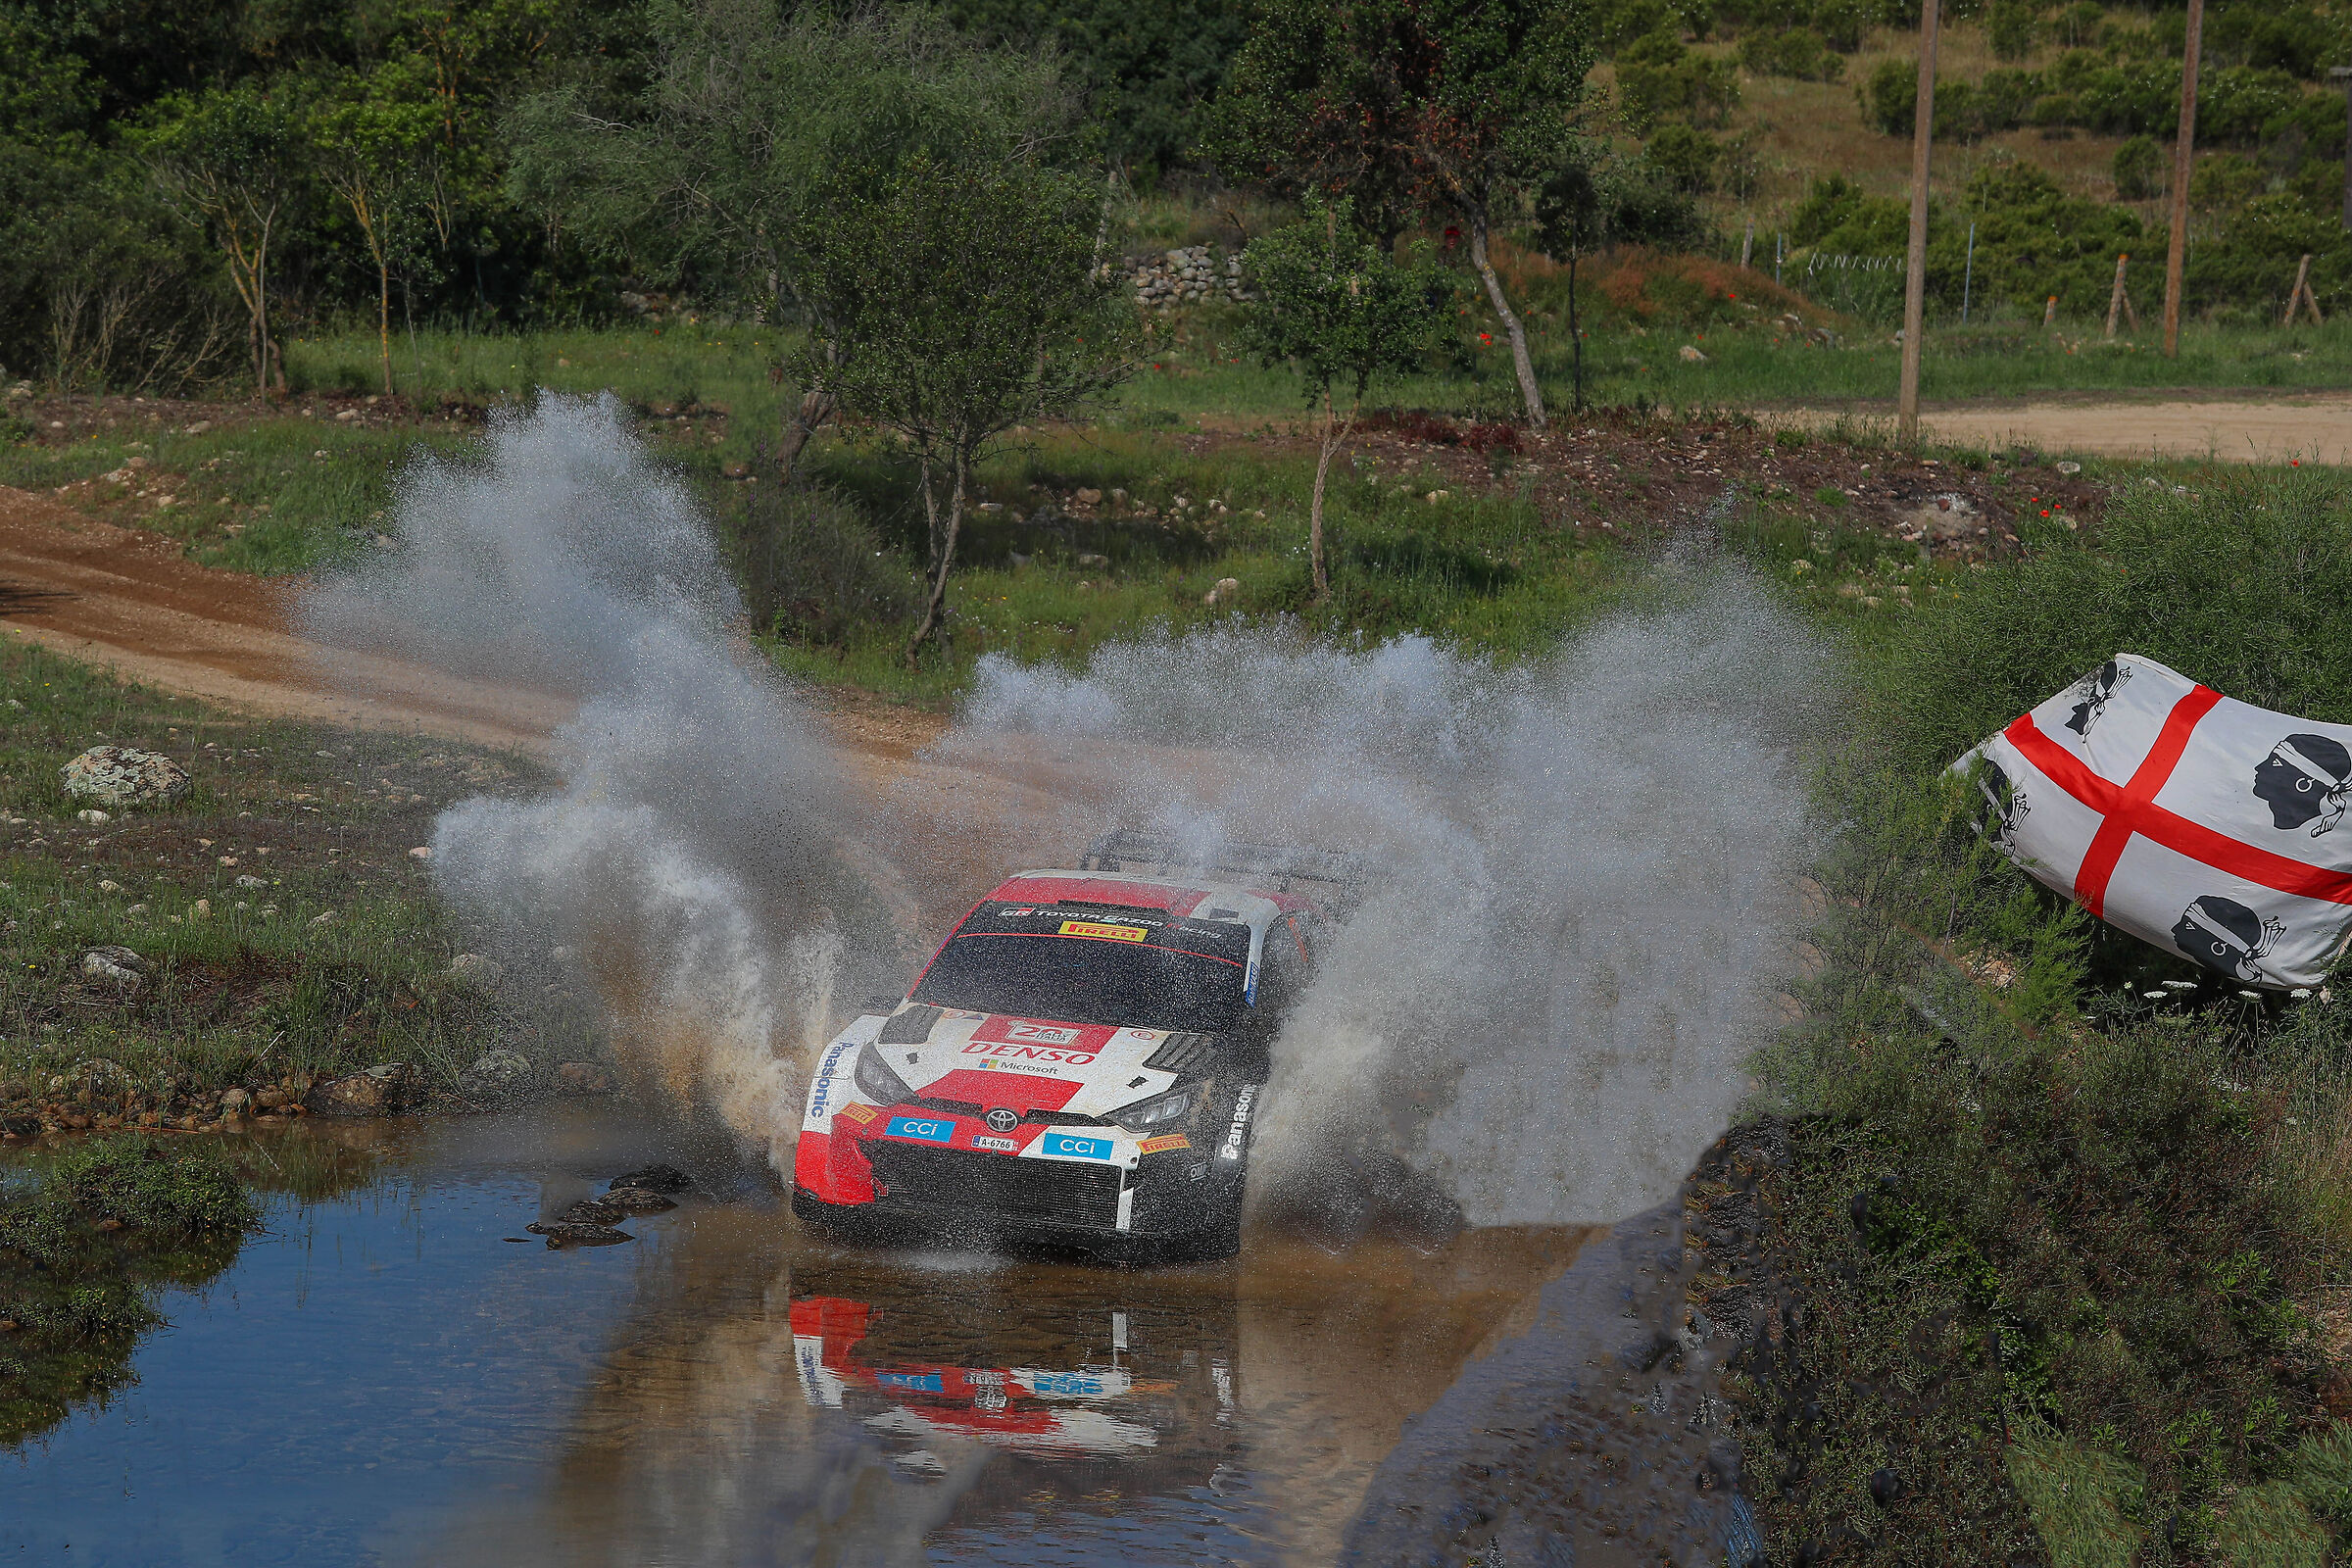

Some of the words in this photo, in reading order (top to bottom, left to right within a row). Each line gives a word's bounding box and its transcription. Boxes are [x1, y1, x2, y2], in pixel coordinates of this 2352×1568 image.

[1037, 910, 1100, 919] TOYOTA
[1104, 914, 1163, 926] GAZOO
[1068, 923, 1139, 939] PIRELLI
[961, 1042, 1096, 1065] DENSO
[1000, 1061, 1058, 1075] Microsoft
[811, 1041, 854, 1118] Panasonic
[844, 1103, 870, 1122] PIRELLI
[981, 1138, 1011, 1150] A-6766
[1140, 1137, 1188, 1152] PIRELLI
